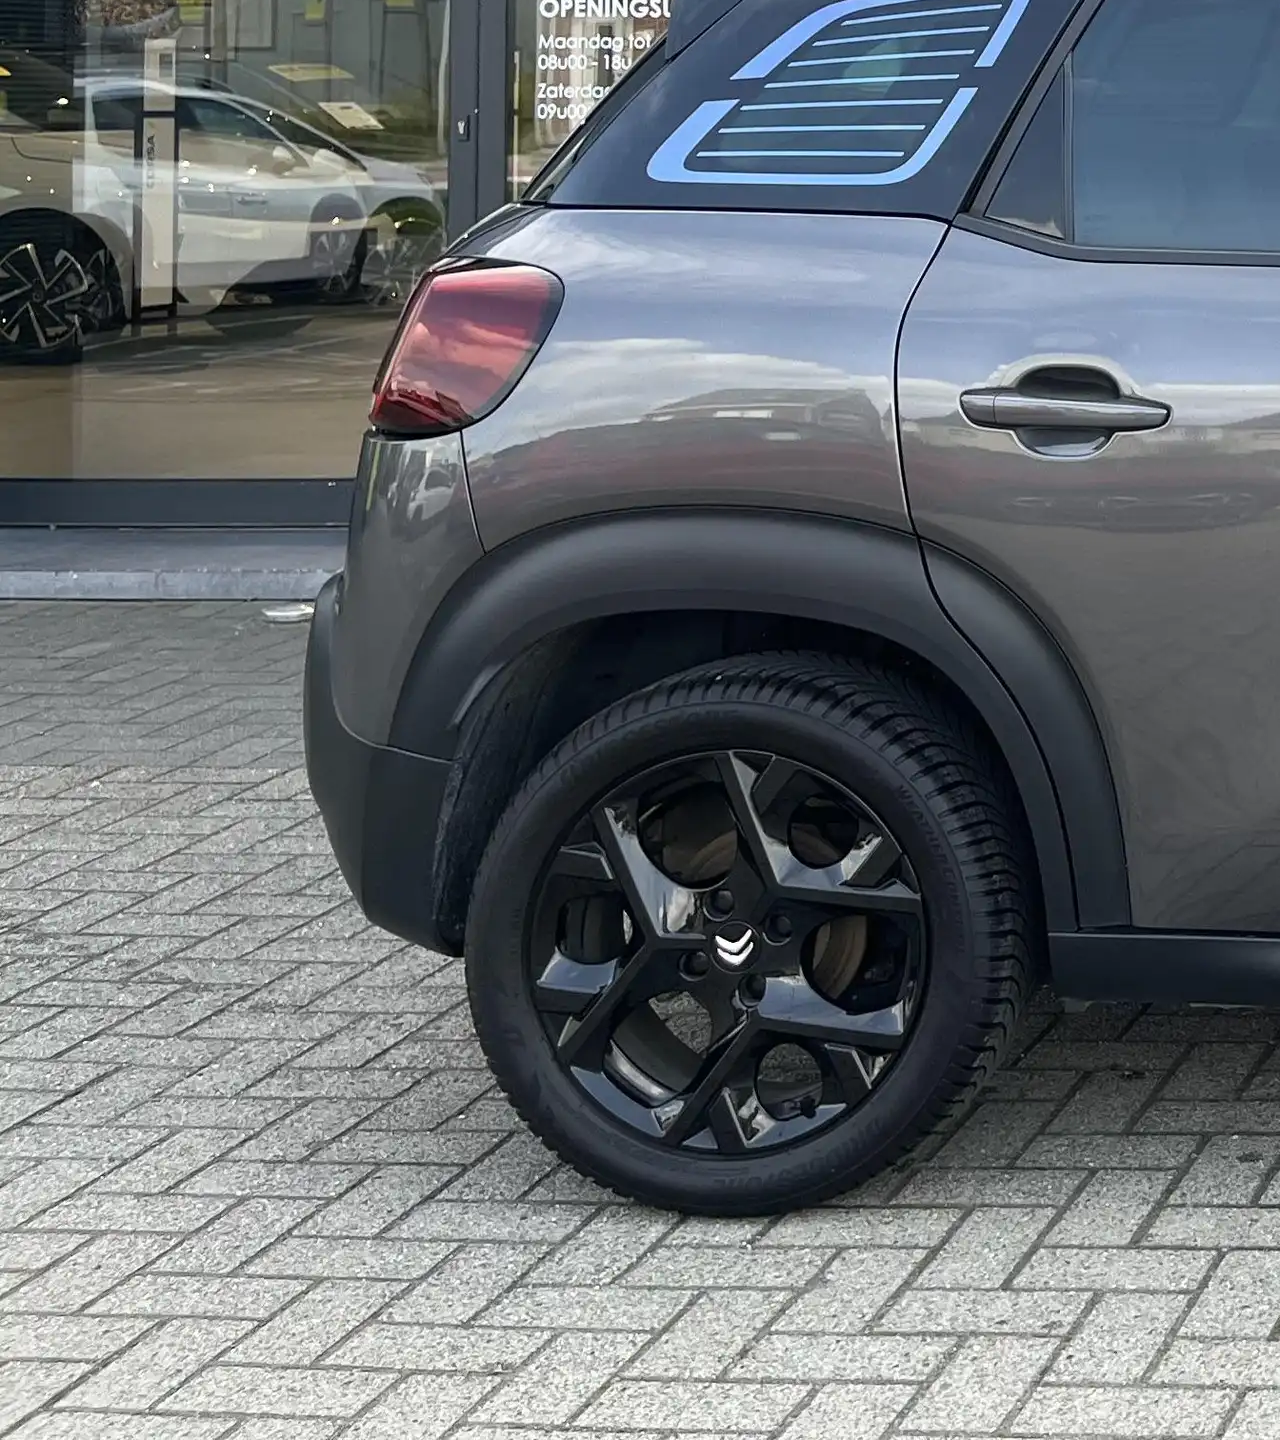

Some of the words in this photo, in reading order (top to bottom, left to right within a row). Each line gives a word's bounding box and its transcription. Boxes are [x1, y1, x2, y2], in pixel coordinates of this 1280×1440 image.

[538, 33, 624, 53] Maandag
[629, 34, 652, 49] tot
[537, 55, 588, 70] 08u00
[604, 55, 632, 70] 18u
